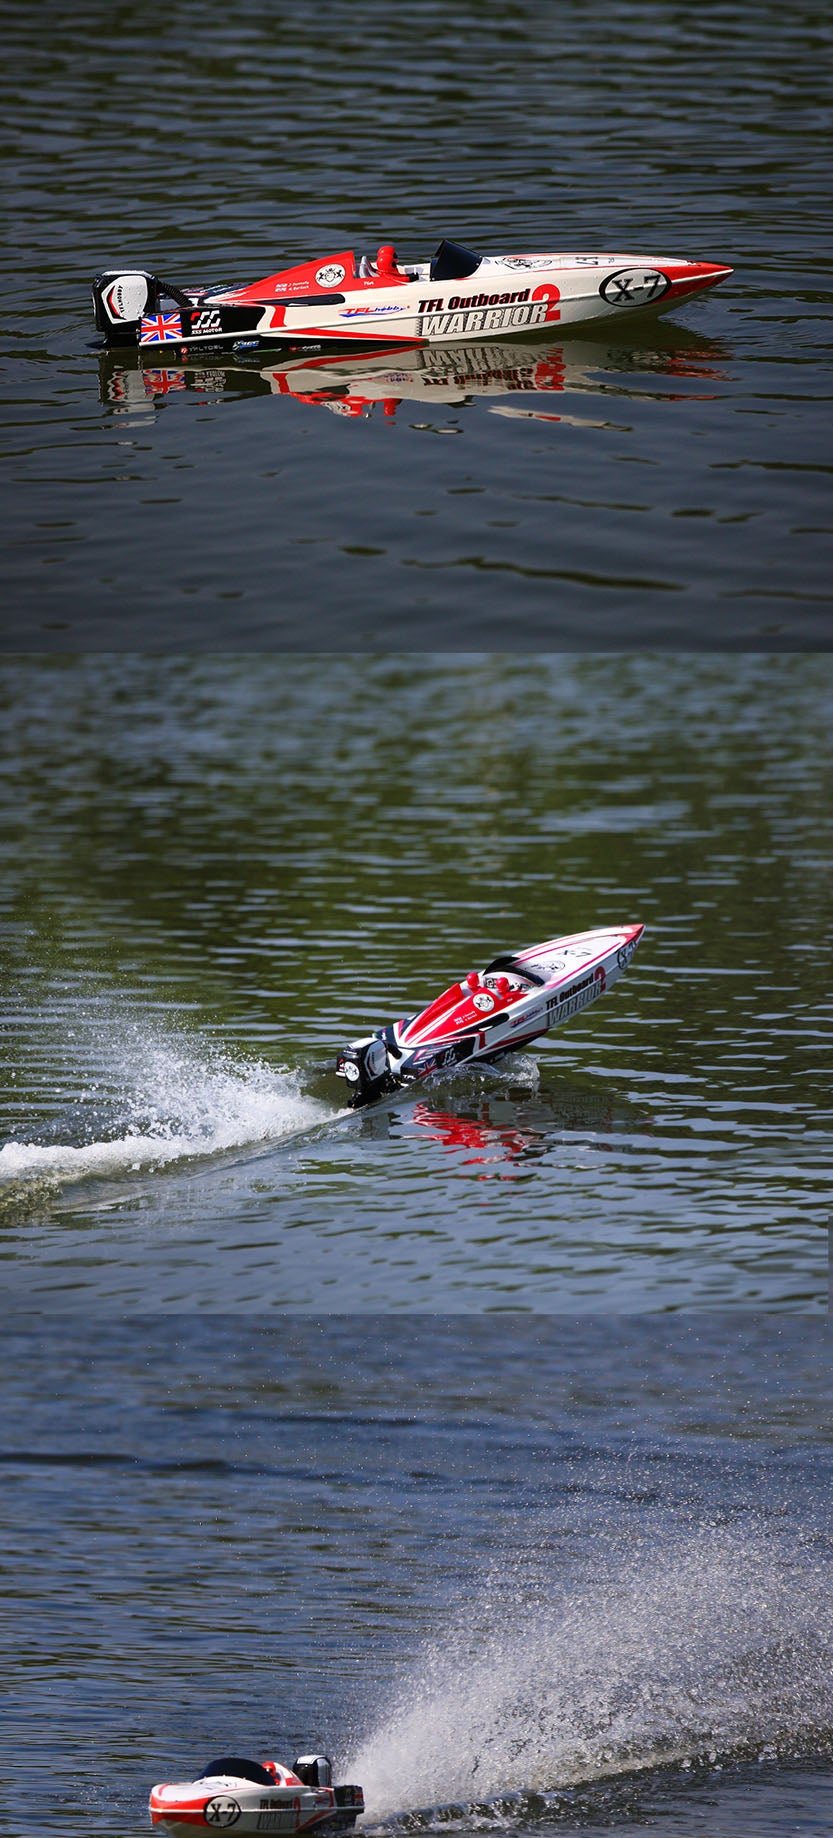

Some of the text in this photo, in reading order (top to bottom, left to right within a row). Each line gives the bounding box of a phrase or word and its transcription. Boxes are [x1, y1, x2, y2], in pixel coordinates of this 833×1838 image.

[418, 288, 531, 313] TFL Outboard
[610, 274, 661, 301] X-7
[417, 284, 561, 337] WARRIOR 2
[594, 966, 606, 994] 2
[545, 998, 558, 1011] TFL
[208, 1803, 237, 1823] X-7
